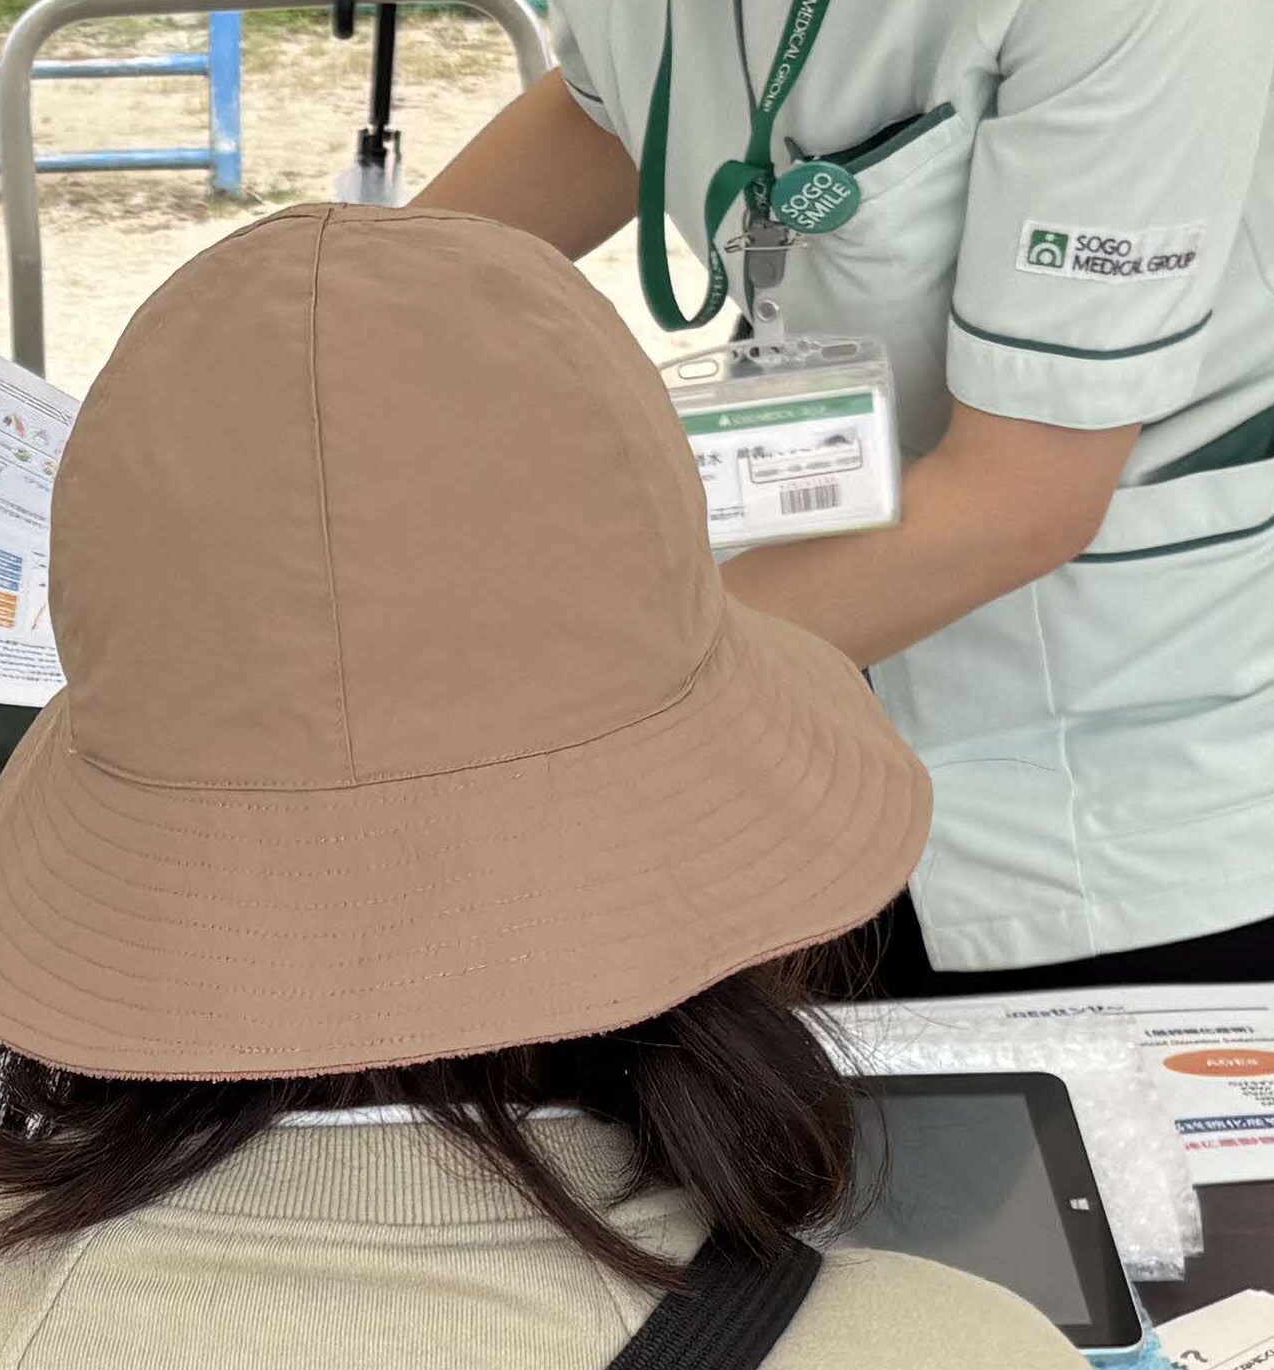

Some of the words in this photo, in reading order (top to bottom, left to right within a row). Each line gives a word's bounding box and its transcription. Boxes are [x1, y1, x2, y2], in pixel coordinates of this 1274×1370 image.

[781, 172, 833, 219] SOGO
[797, 182, 851, 229] SMILE
[1072, 255, 1145, 277] MEDICAL
[1147, 251, 1197, 272] GROUP
[1076, 235, 1132, 257] SOGO
